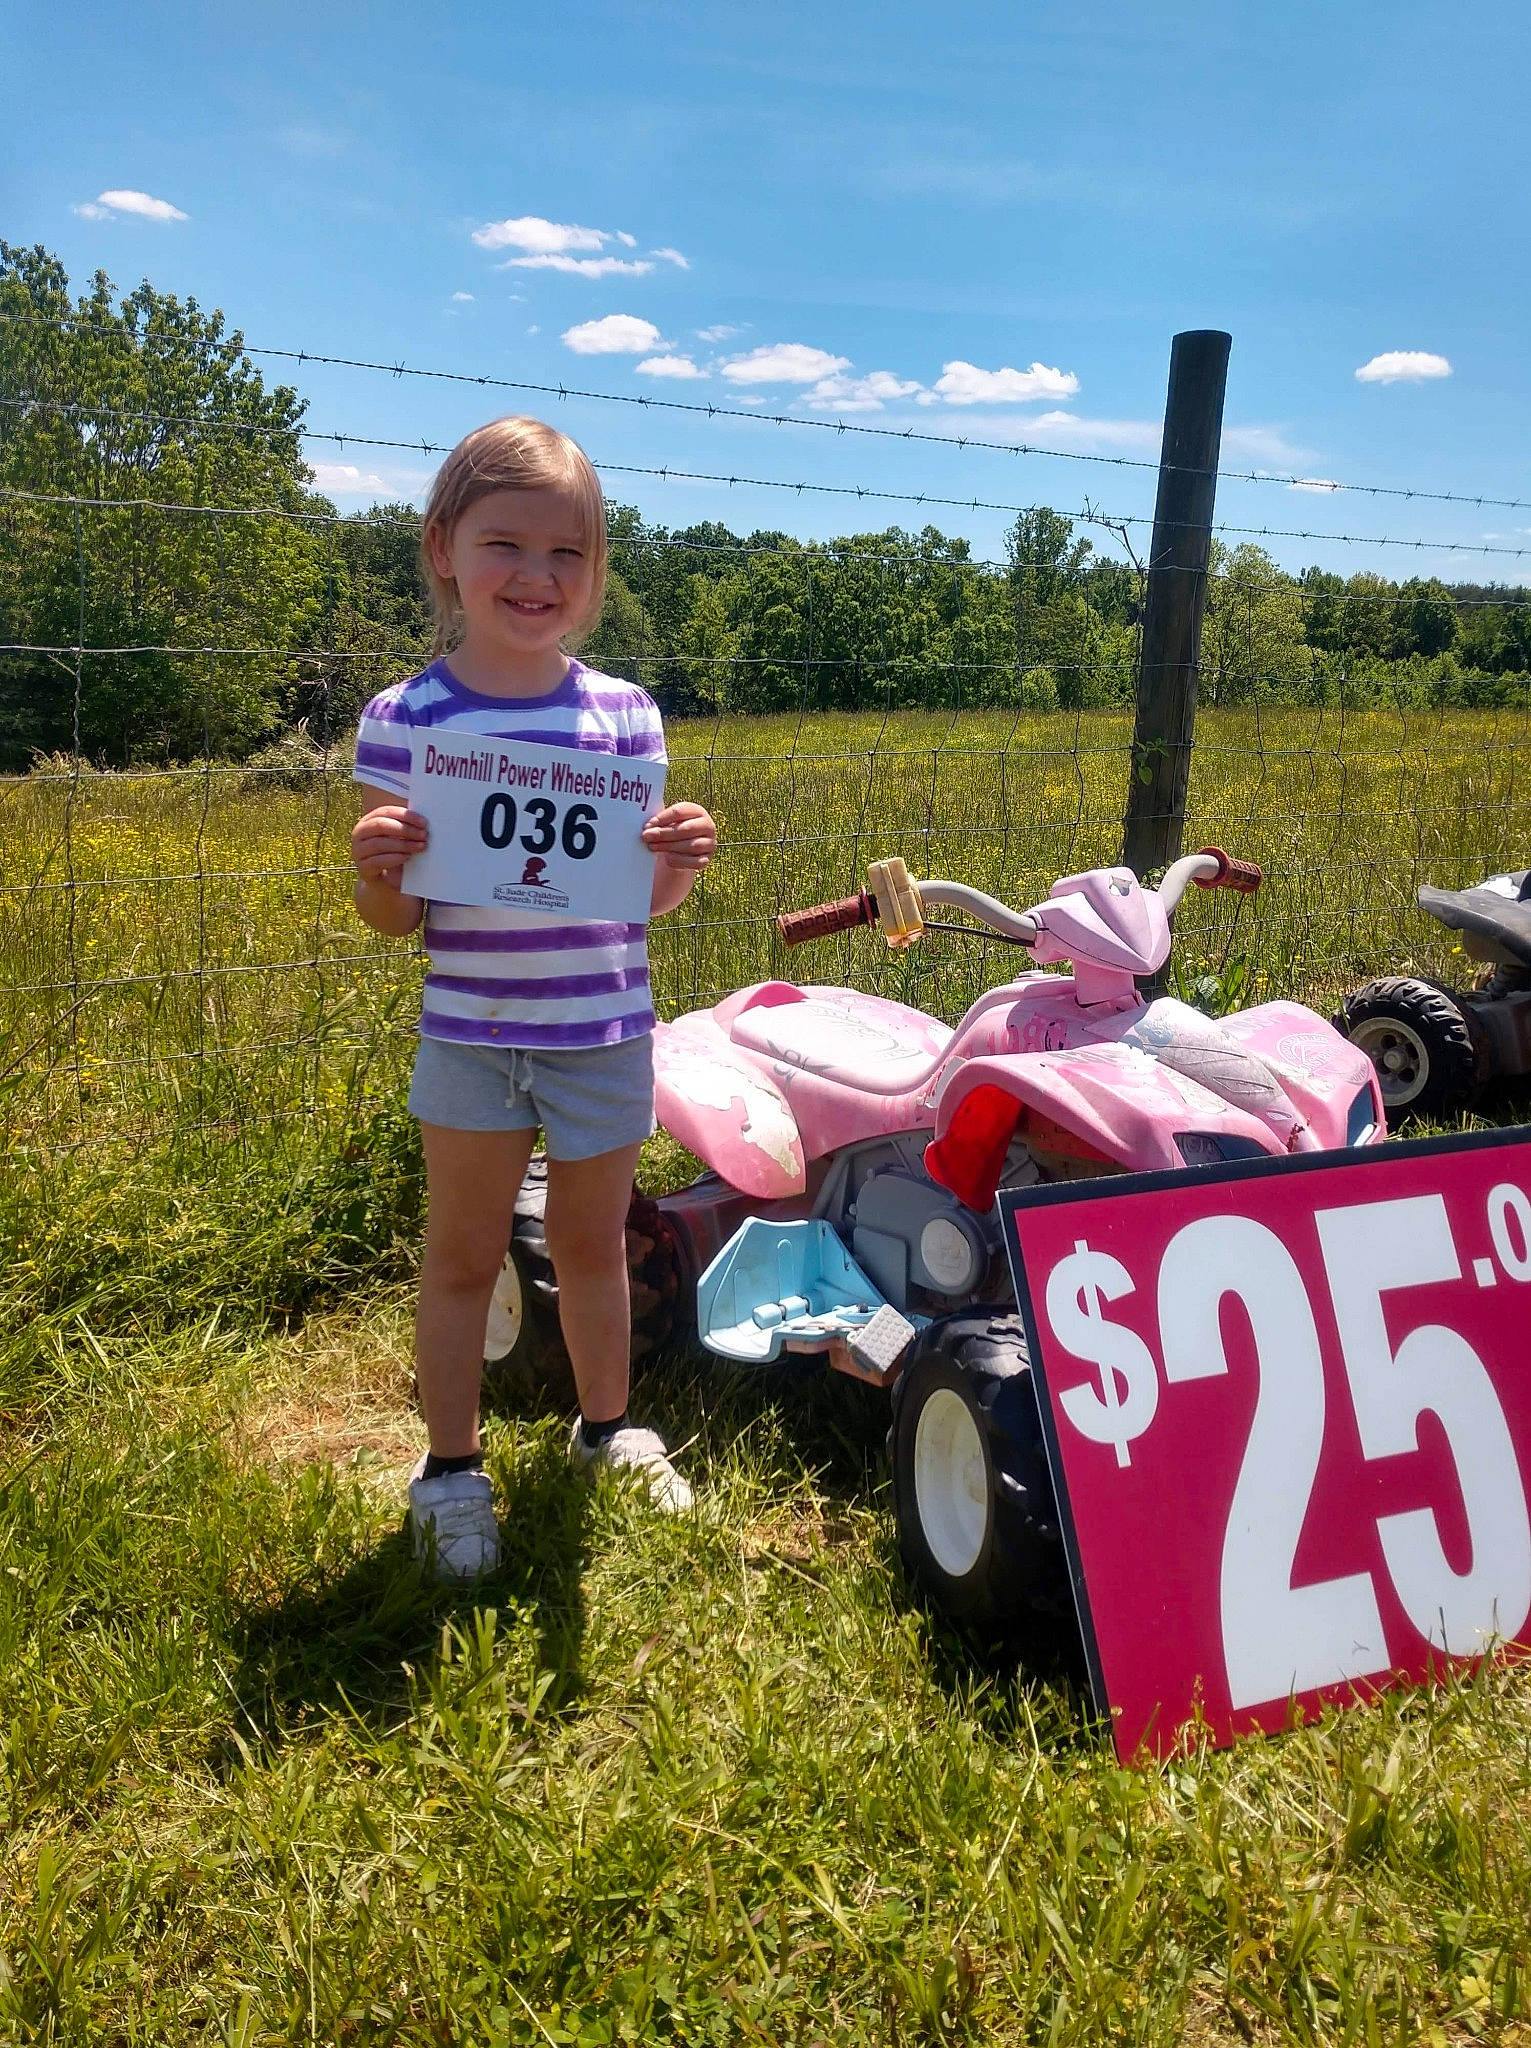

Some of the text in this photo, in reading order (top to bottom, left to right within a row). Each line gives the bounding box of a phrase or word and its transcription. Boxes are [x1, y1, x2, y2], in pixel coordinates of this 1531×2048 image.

[425, 744, 652, 811] Downhill Power Wheels Derby
[480, 792, 599, 860] 036
[493, 892, 532, 904] Research
[533, 898, 569, 908] Hospital
[506, 888, 527, 897] Jude
